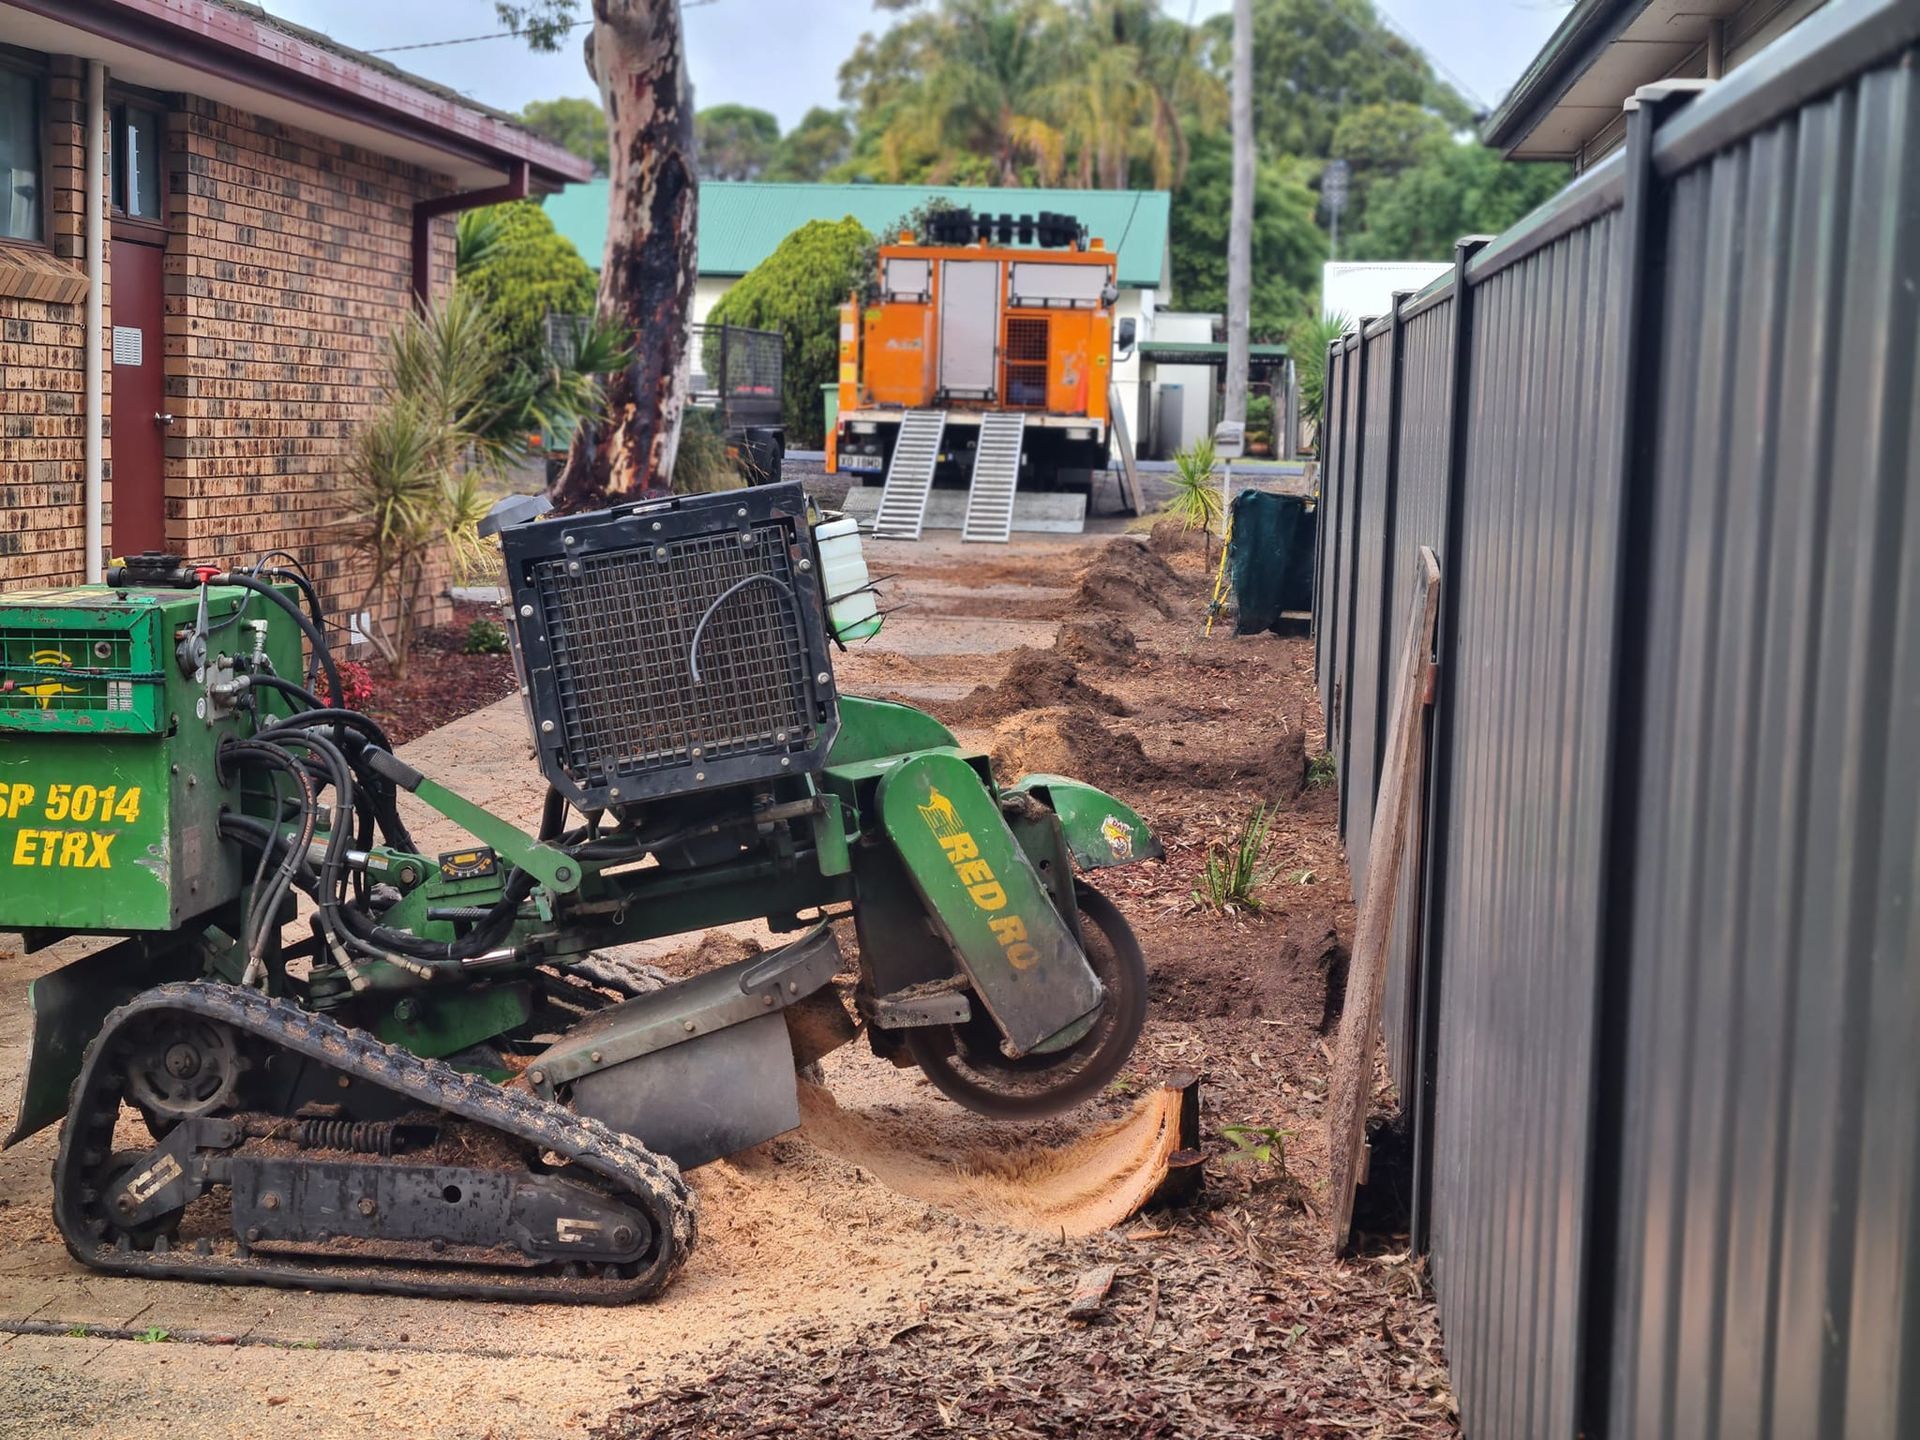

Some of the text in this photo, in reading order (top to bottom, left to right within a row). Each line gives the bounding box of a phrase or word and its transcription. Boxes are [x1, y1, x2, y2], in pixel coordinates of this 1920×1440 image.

[45, 784, 141, 822] 5014
[13, 829, 115, 868] ETRX
[939, 832, 1007, 911] RED
